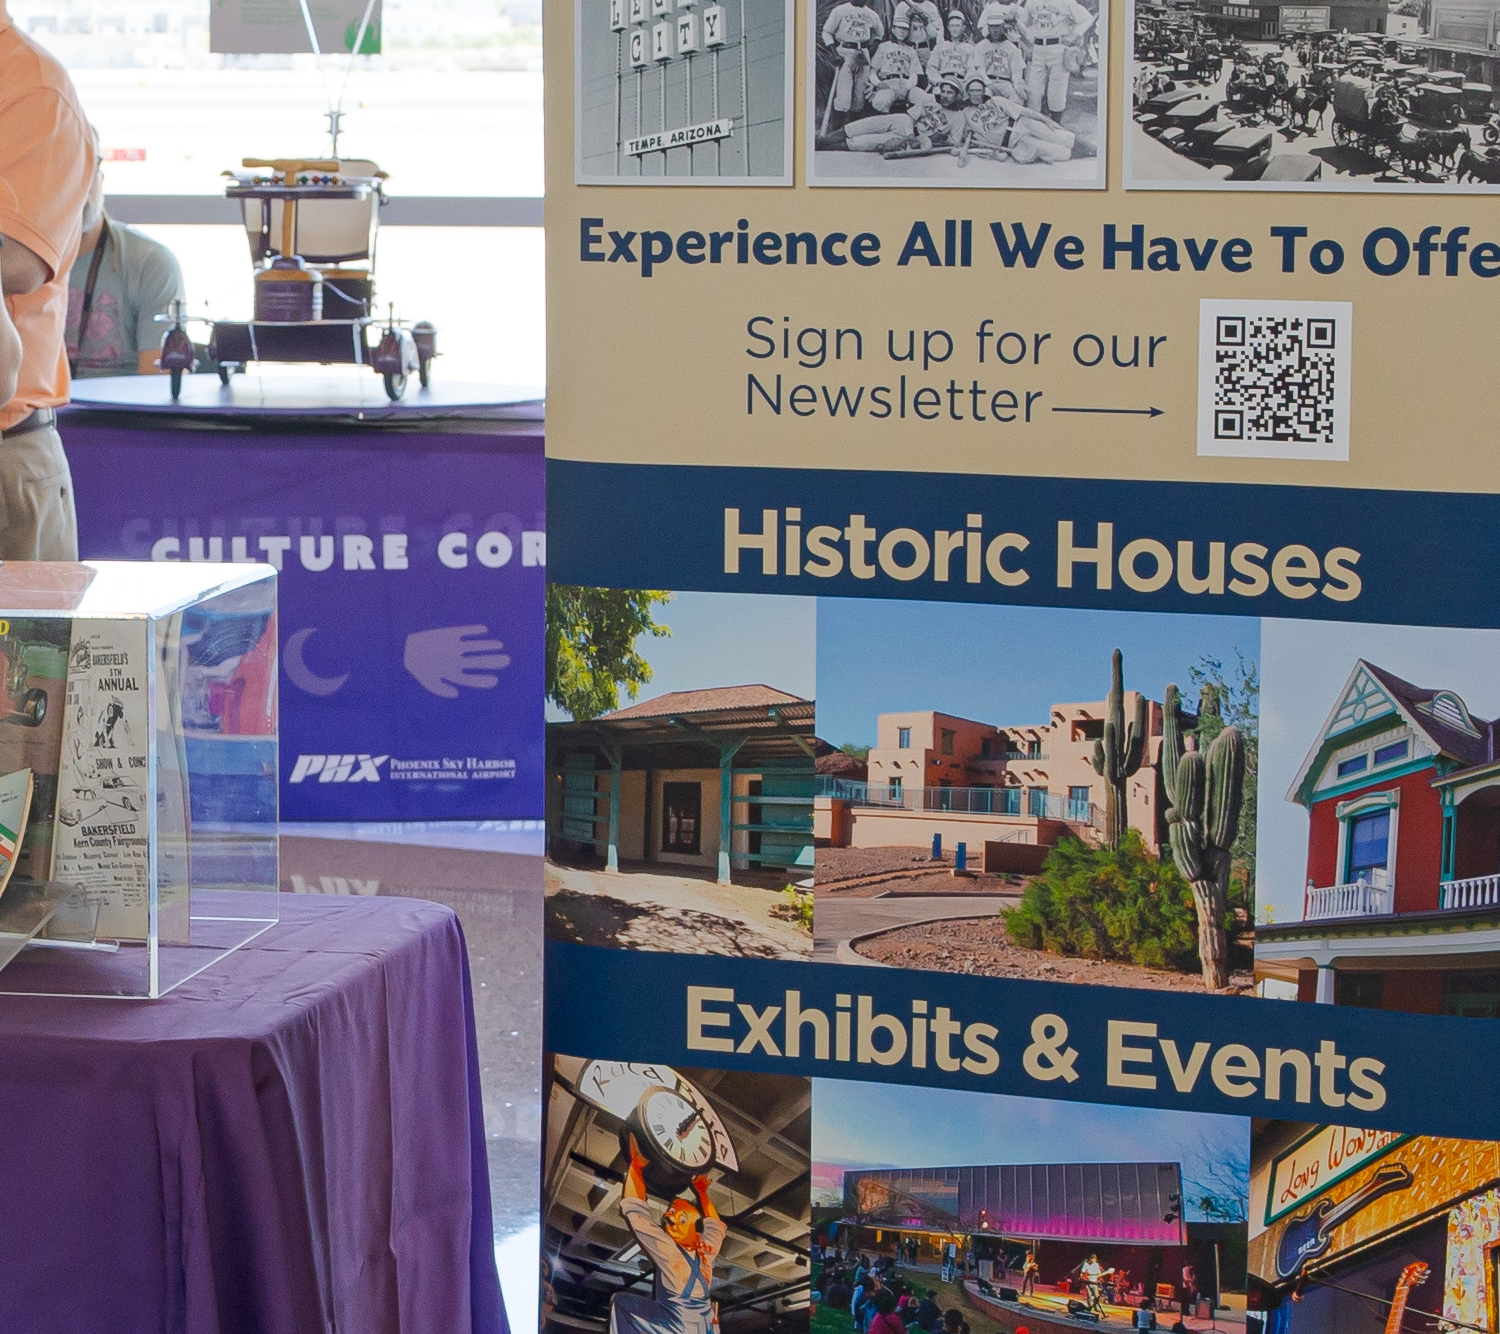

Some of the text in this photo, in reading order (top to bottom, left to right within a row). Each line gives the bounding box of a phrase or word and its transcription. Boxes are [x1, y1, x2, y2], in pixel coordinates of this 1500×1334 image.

[631, 14, 718, 62] CITY
[671, 124, 722, 143] ARIZONA
[578, 217, 881, 277] Experience
[898, 218, 971, 267] All
[997, 222, 1085, 268] We
[1102, 222, 1252, 272] Have
[1270, 226, 1344, 274] To
[745, 315, 1167, 371] Sign up for our
[747, 373, 1042, 424] Newsletter
[151, 534, 409, 572] CULTURE
[722, 506, 1363, 603] Historic Houses
[98, 677, 139, 691] ANNUAL
[289, 754, 390, 784] PHX
[685, 984, 1387, 1112] Exhibits & Events
